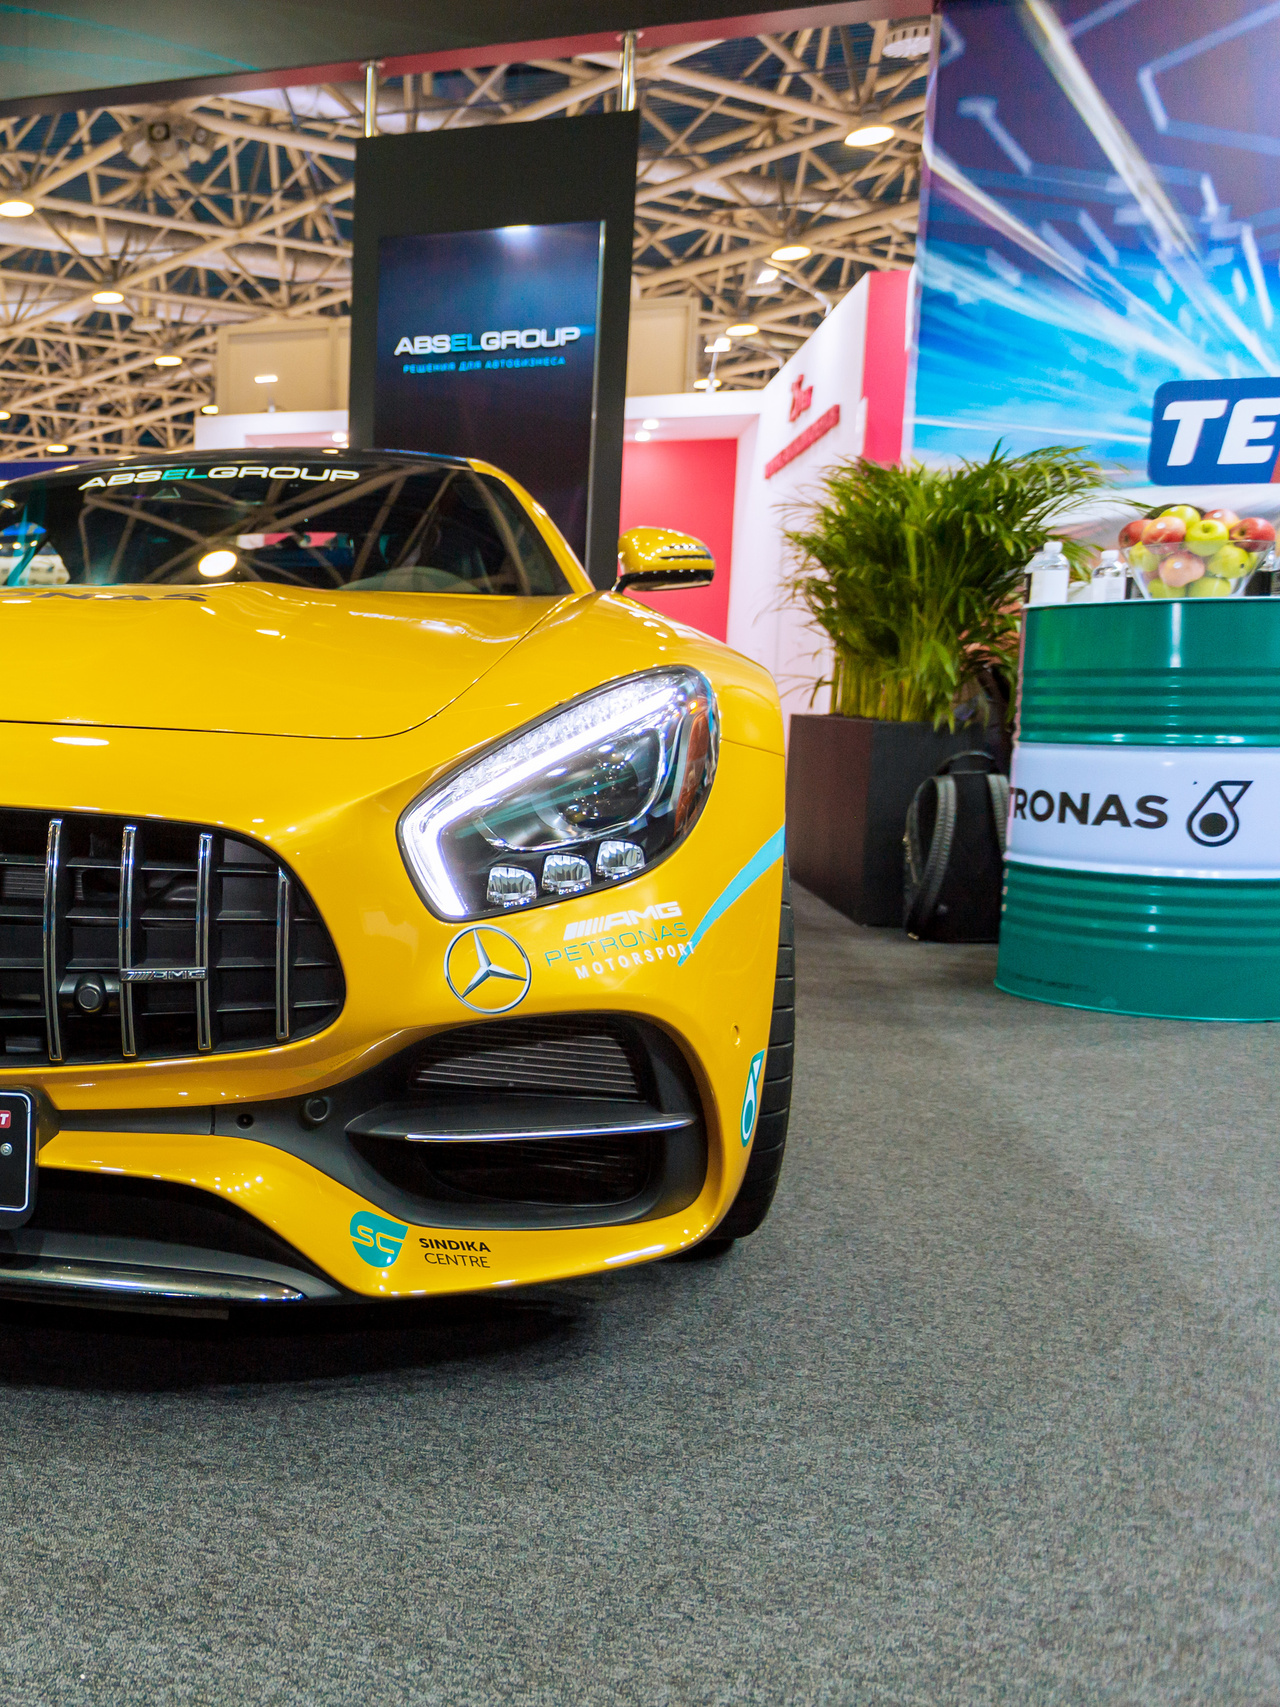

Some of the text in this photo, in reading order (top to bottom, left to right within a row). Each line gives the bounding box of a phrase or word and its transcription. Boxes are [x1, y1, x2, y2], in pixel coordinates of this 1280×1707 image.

[394, 326, 581, 356] ABSELGROUP
[402, 355, 567, 374] РЕШЕНИЯ ДЛЯ АВТОБИЗНЕСА
[78, 466, 360, 491] ABSELGROUP
[544, 922, 689, 967] PETRONAS
[574, 941, 695, 980] MOTORSPORT
[418, 1238, 492, 1253] SINDIKA
[424, 1252, 491, 1269] CENTRE
